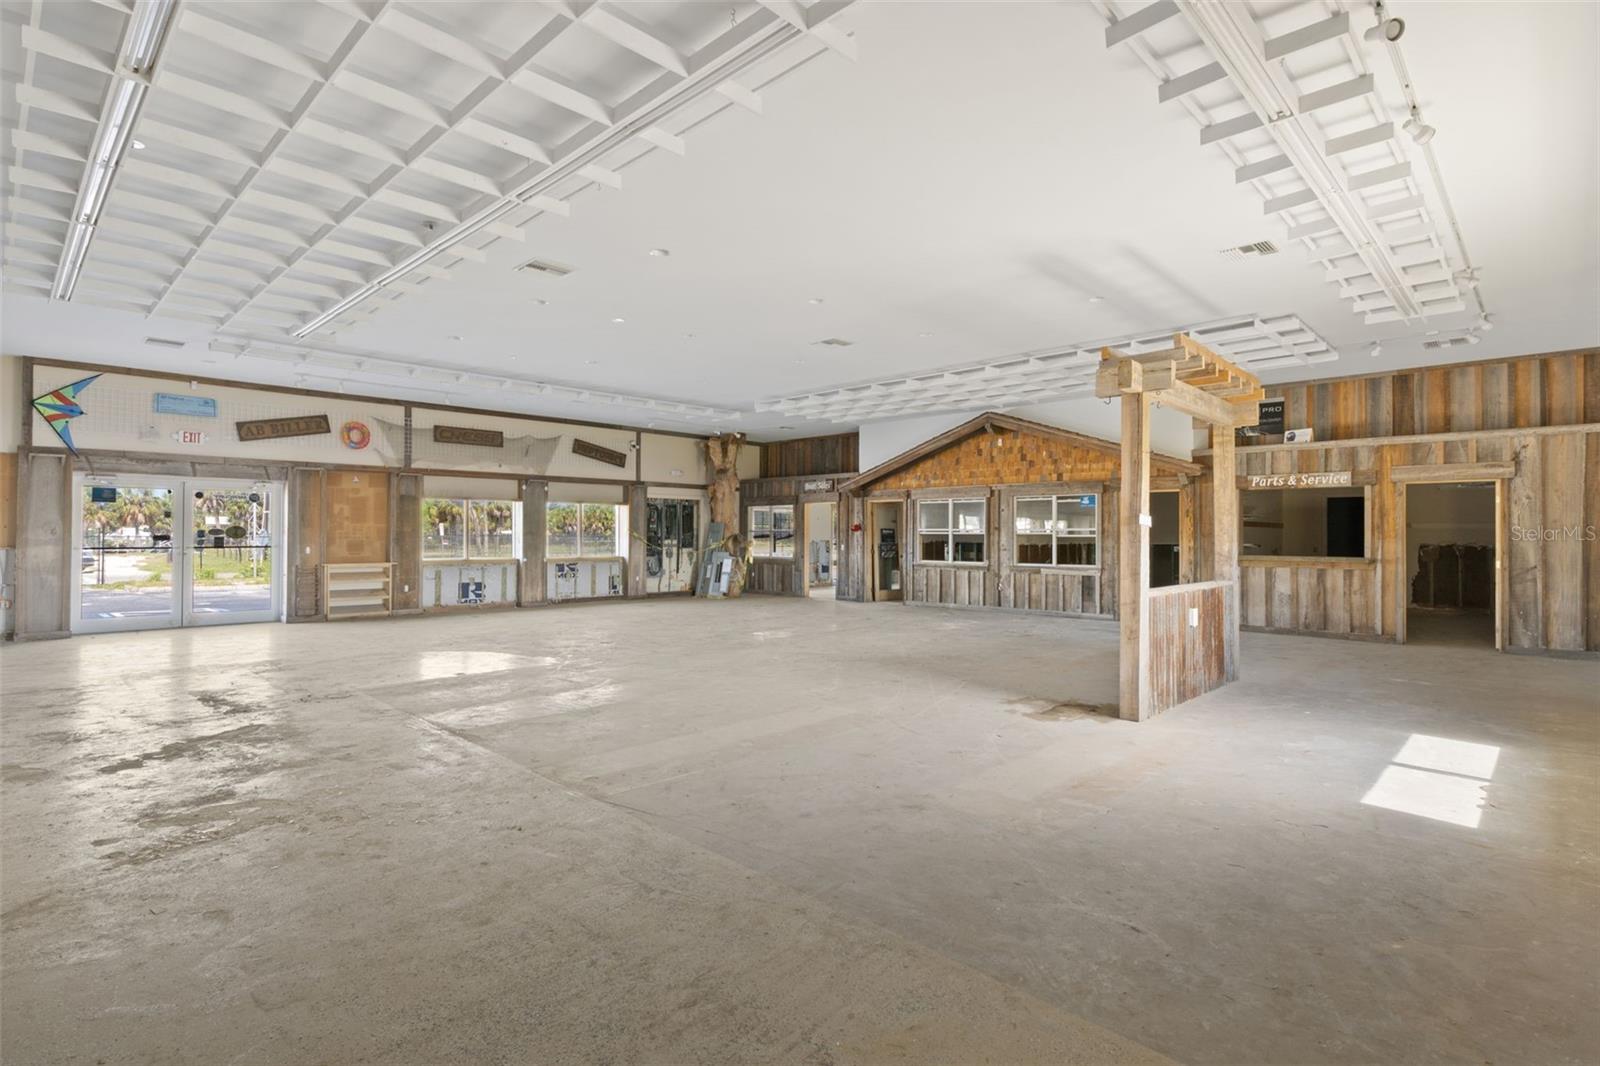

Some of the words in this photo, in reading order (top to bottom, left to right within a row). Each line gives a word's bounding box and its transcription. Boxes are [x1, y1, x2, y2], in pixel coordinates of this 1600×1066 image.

[1262, 405, 1282, 413] PRO
[245, 424, 265, 437] AB
[183, 431, 201, 443] EXIT
[1251, 476, 1285, 488] Parts
[1287, 474, 1297, 486] &
[1300, 472, 1349, 485] Service
